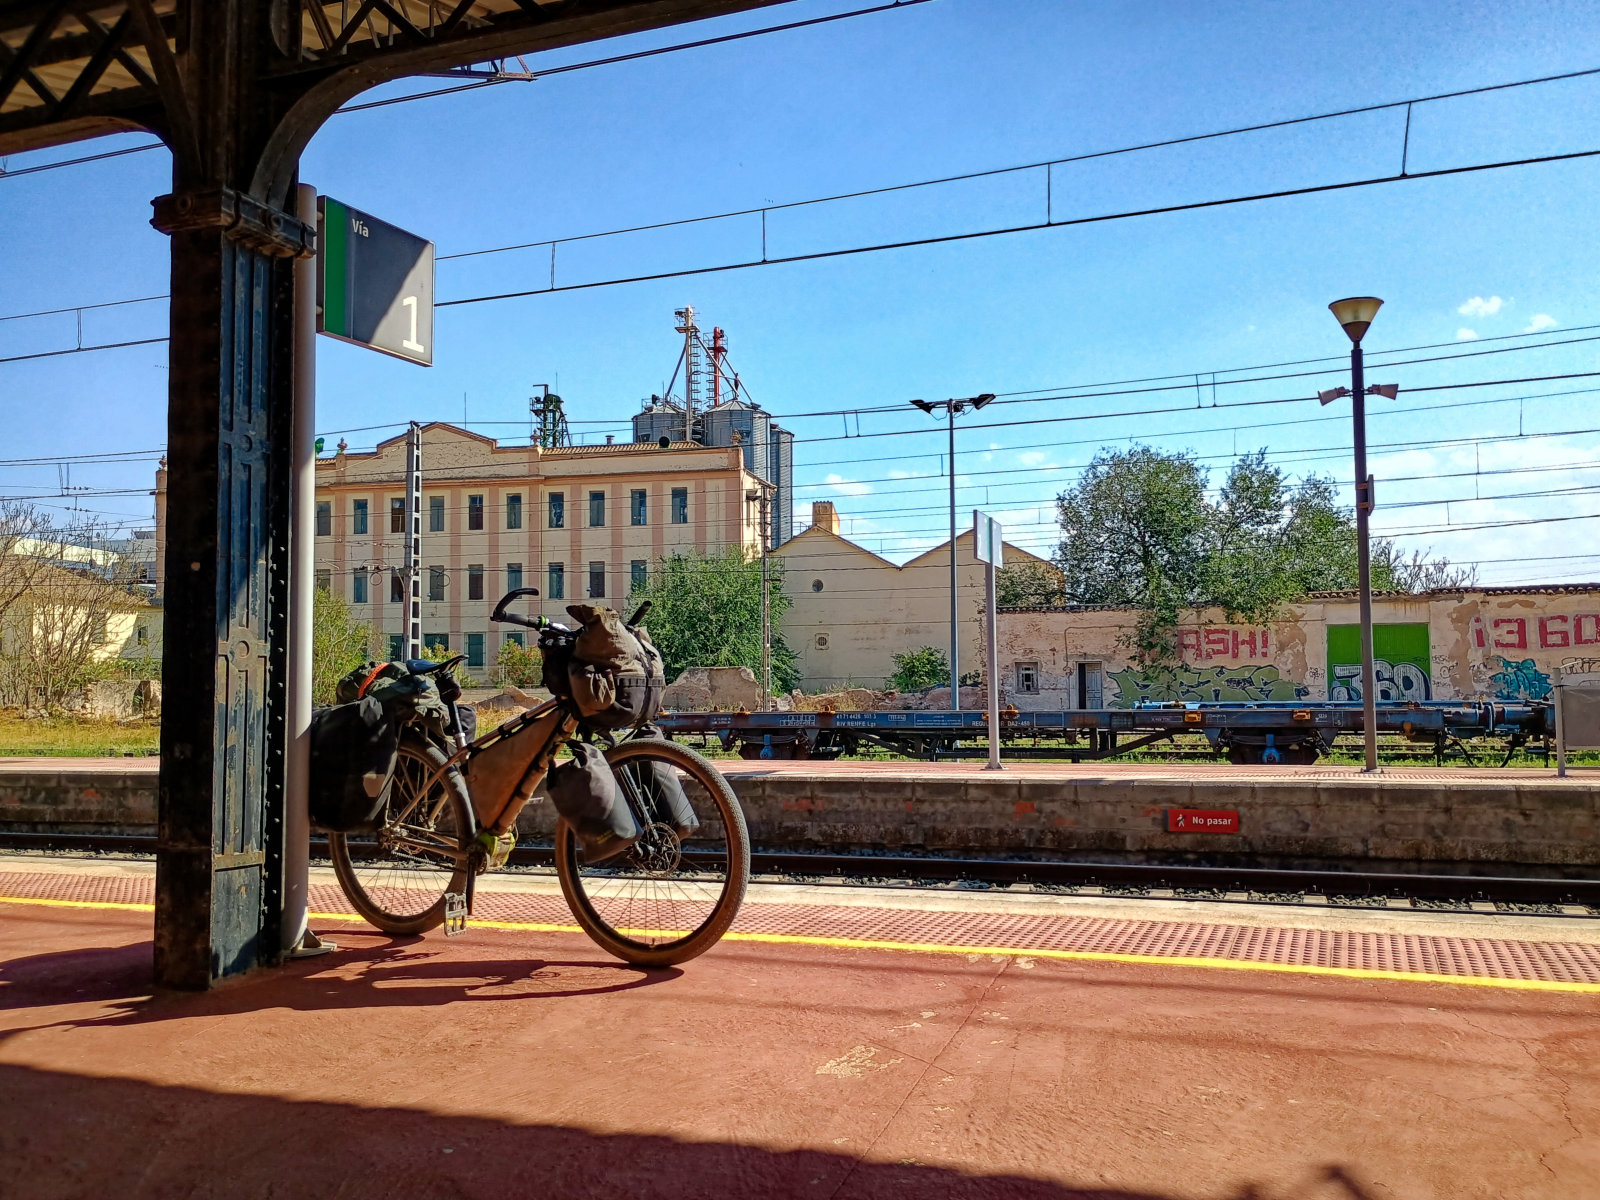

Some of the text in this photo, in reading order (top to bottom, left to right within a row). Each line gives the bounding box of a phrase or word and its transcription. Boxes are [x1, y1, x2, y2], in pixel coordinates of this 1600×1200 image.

[352, 219, 369, 237] Vía
[403, 296, 425, 353] 1
[1192, 816, 1232, 826] No pasar
